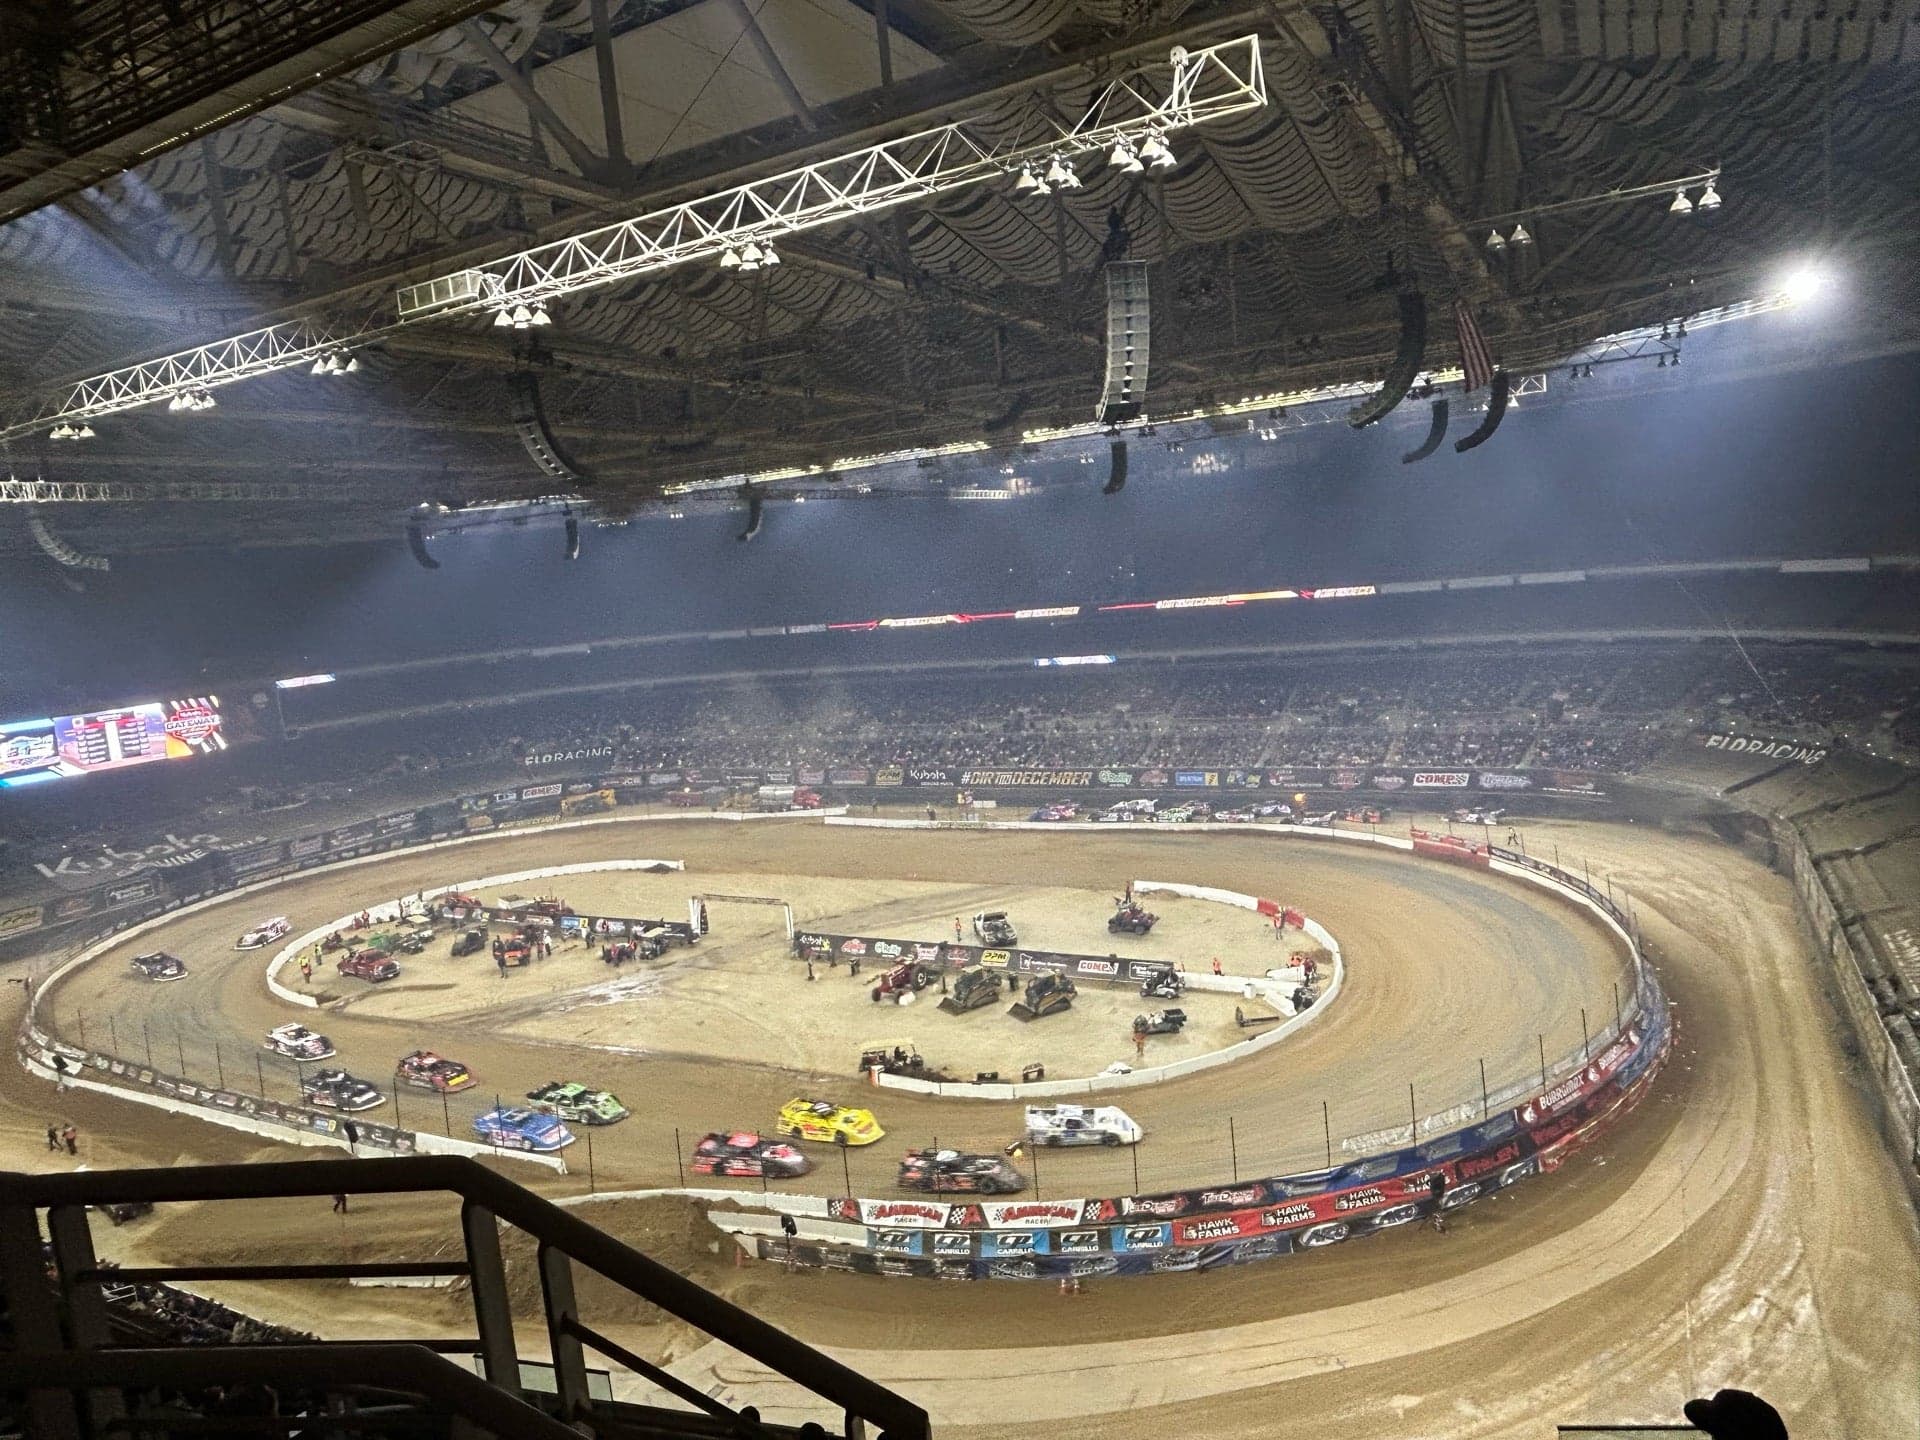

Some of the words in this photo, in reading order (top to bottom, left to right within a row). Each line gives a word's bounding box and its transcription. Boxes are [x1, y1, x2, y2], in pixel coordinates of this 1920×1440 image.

[166, 716, 217, 730] GATEWAY
[1080, 961, 1109, 972] COMP
[1350, 1187, 1381, 1201] HAWK
[1349, 1196, 1386, 1209] FARMS
[875, 1204, 944, 1223] AMERICAN
[1001, 1205, 1078, 1223] AMERICAN
[1276, 1203, 1310, 1216] HAWK
[1199, 1217, 1233, 1229] HAWK
[1276, 1211, 1316, 1226] FARMS
[1199, 1226, 1240, 1239] FARMS
